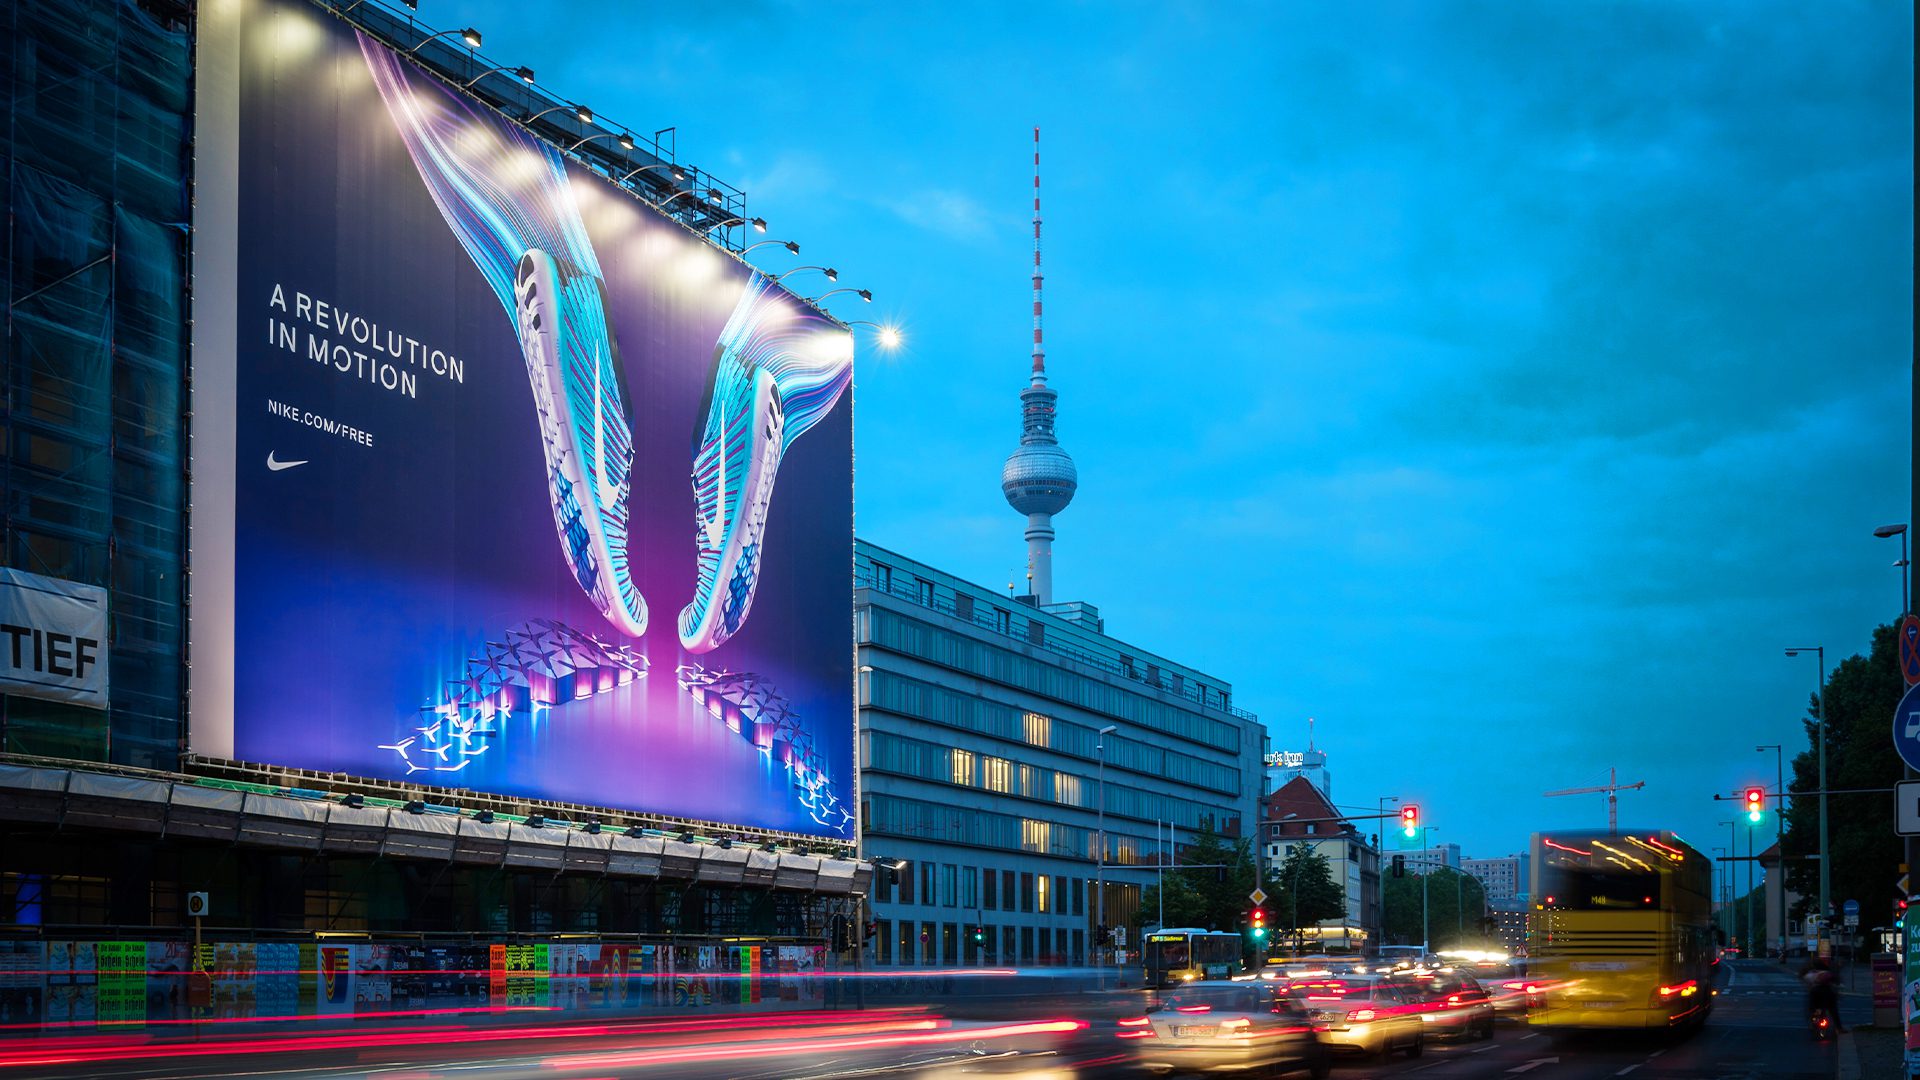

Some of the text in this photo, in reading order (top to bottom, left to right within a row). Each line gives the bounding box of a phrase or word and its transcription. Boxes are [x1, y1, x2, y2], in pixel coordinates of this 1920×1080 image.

[269, 283, 463, 384] A REVOLUTION
[269, 318, 416, 399] IN MOTION
[268, 399, 373, 447] NIKE.COM/FREE
[0, 623, 98, 679] TIEF
